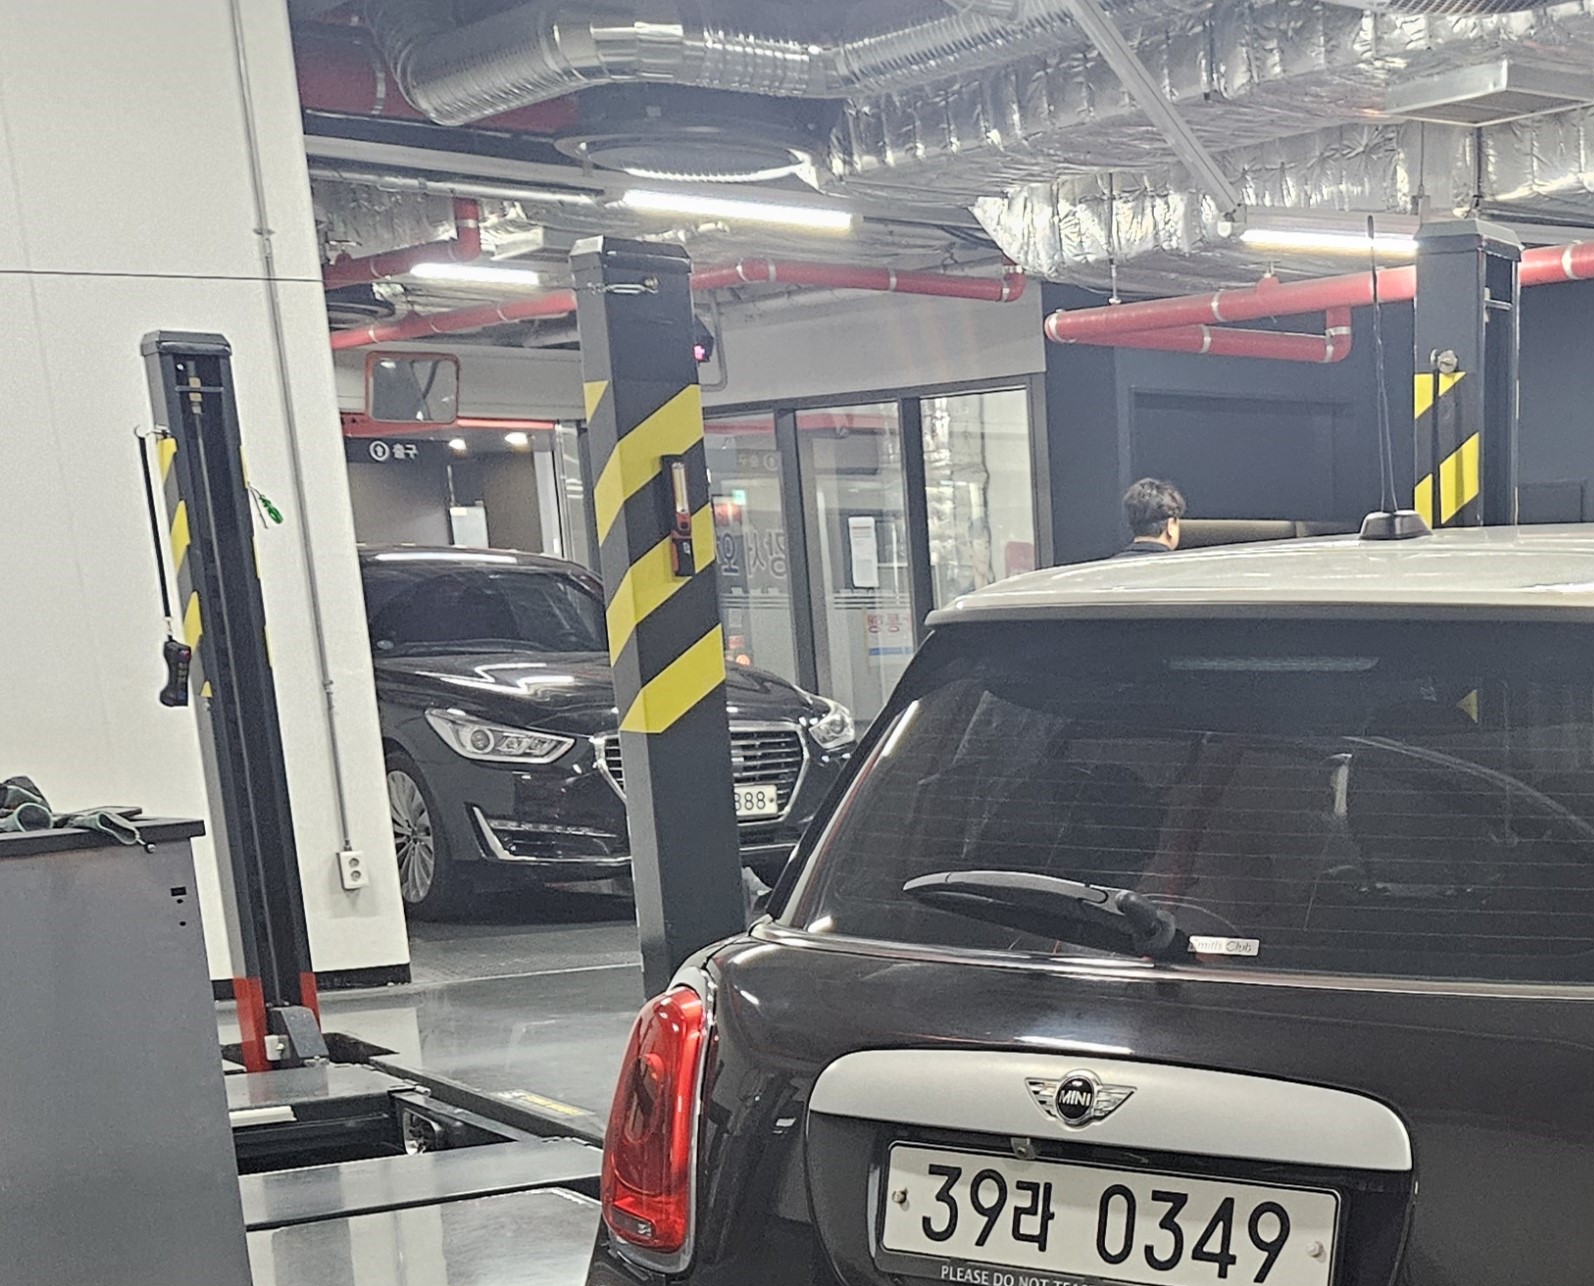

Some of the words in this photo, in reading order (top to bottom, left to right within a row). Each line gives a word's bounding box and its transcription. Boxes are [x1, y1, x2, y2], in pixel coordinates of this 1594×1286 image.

[1059, 1089, 1092, 1107] MINI
[922, 1163, 1055, 1252] 39라
[1096, 1183, 1291, 1284] 0349
[941, 1265, 989, 1286] PLEASE
